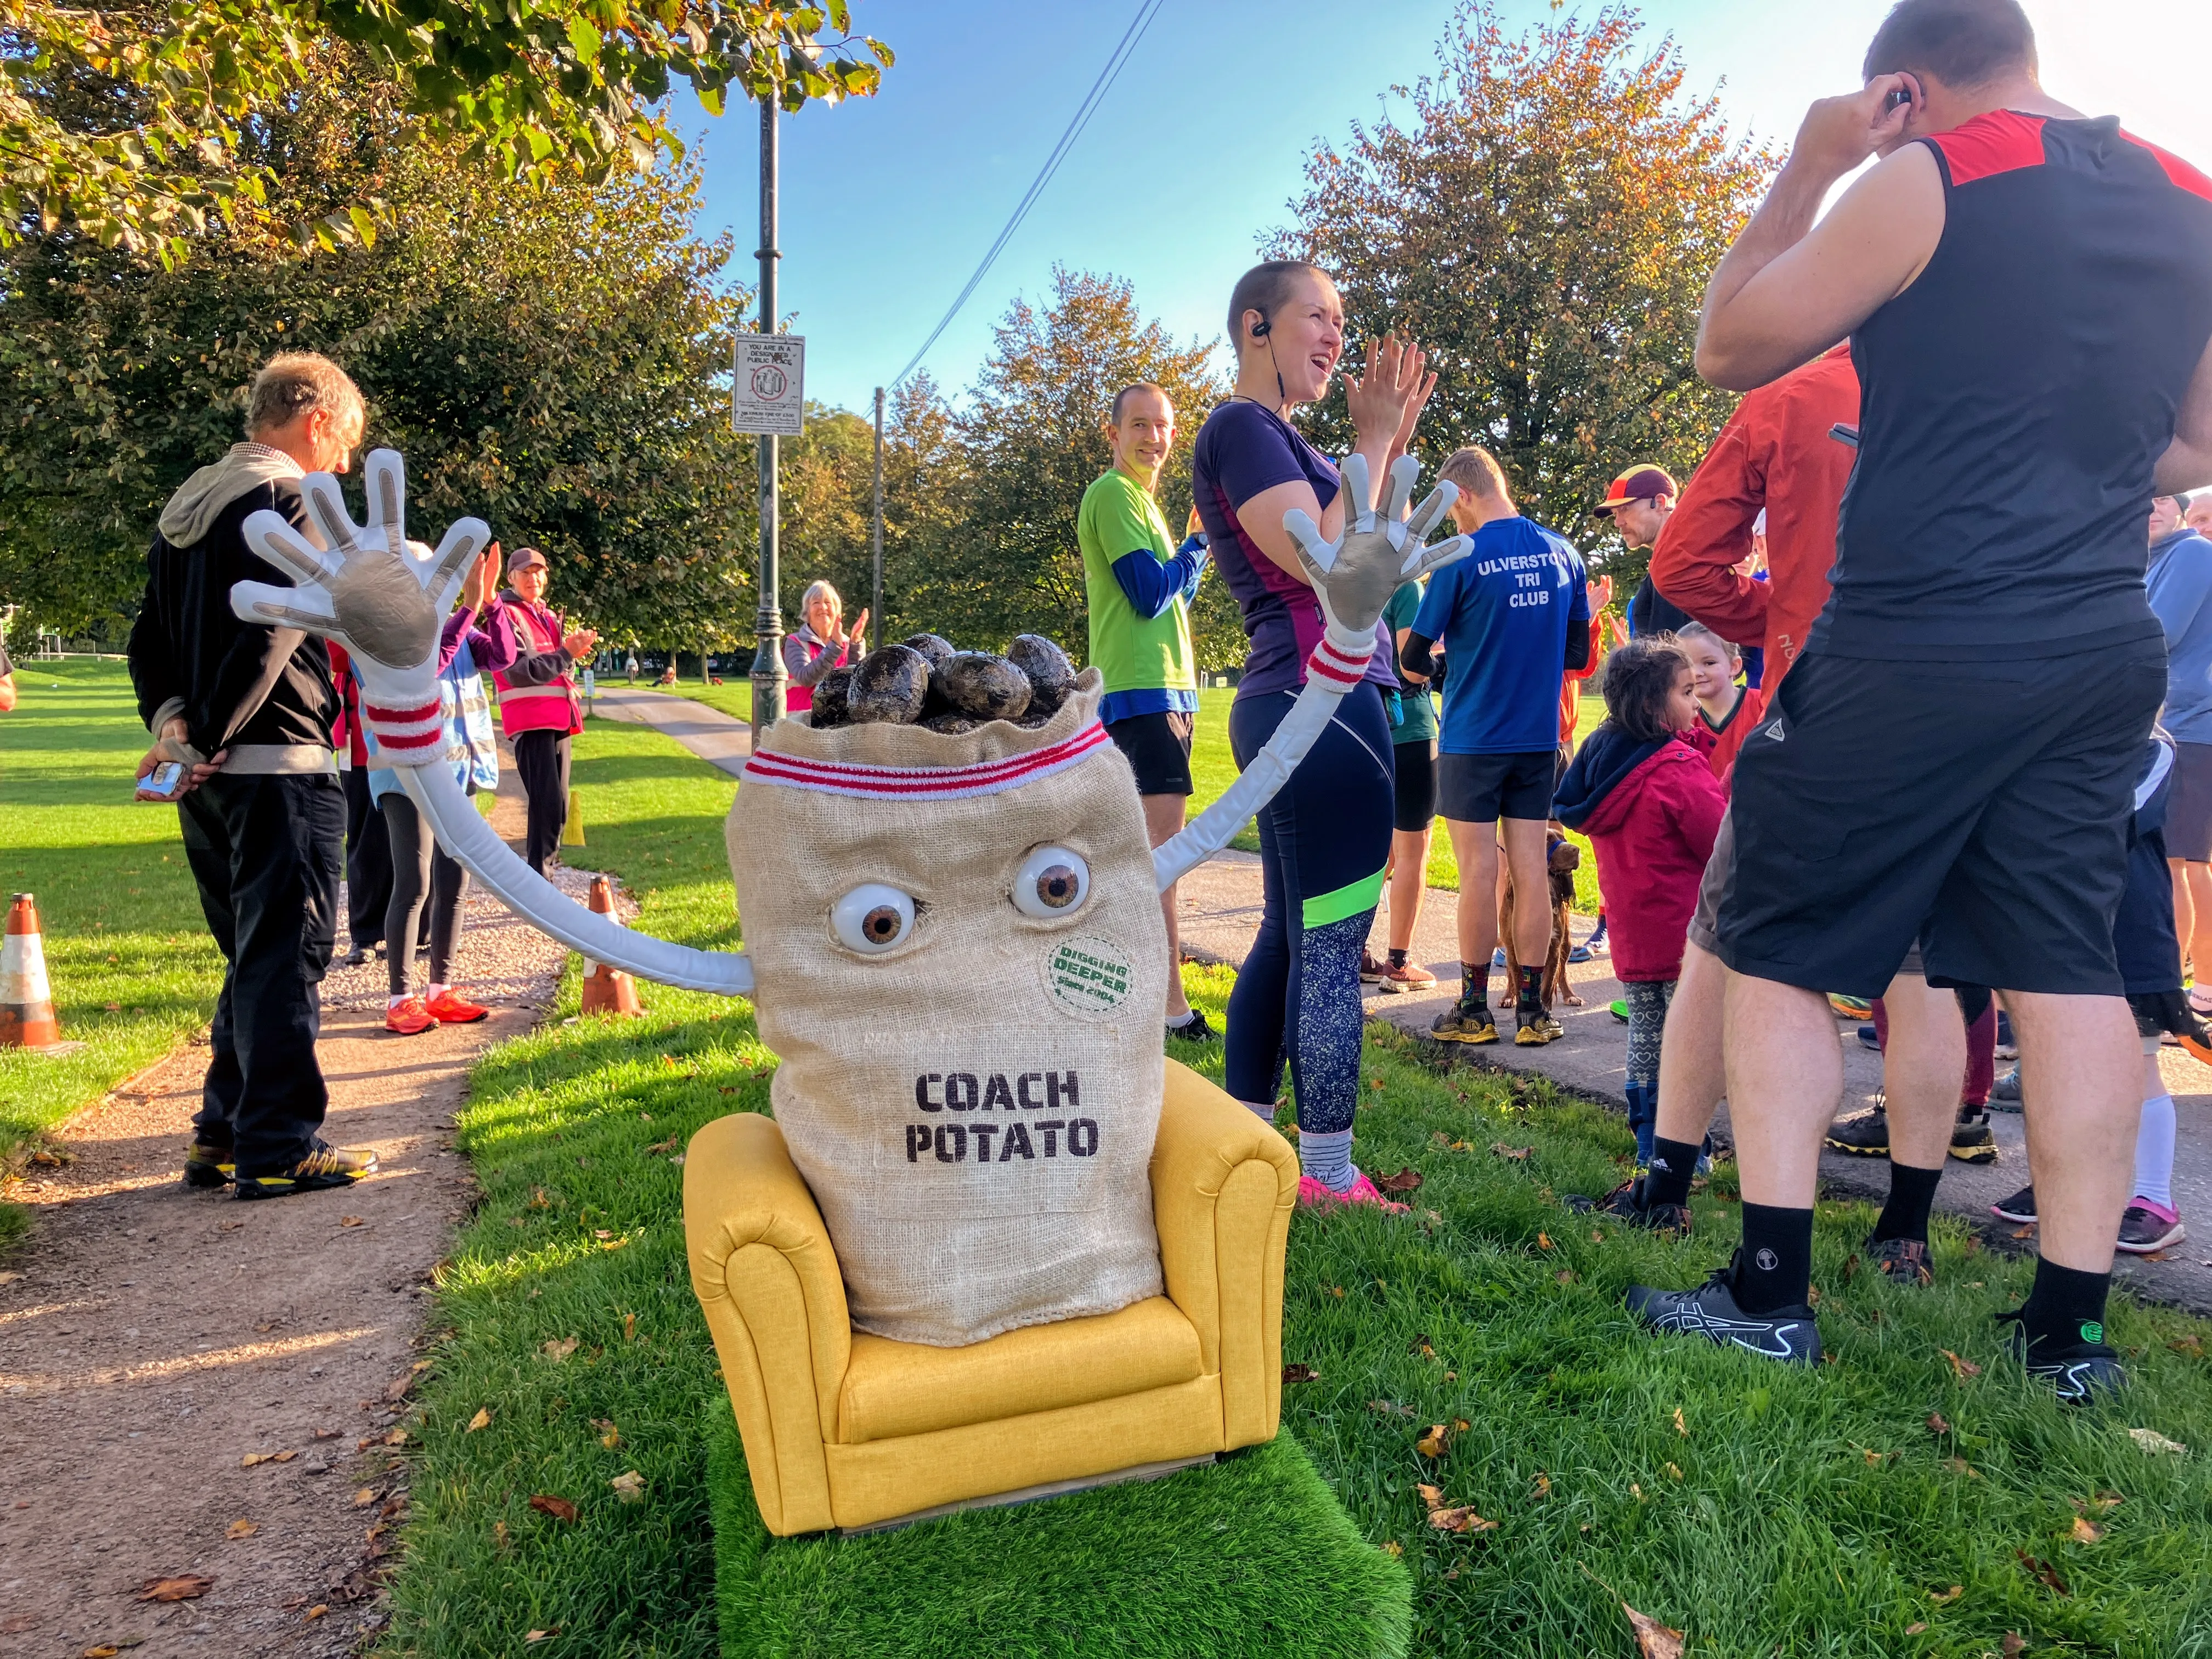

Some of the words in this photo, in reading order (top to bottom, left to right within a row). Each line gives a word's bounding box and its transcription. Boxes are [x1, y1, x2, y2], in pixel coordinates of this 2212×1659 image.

[1477, 552, 1568, 576] ULVERSTON
[1515, 572, 1541, 588] TRI
[1509, 590, 1549, 608] CLUB
[1053, 957, 1127, 994] DEEPER
[1060, 946, 1128, 978] DIGGING
[916, 1071, 1080, 1112] COACH
[906, 1118, 1098, 1163] POTATO
